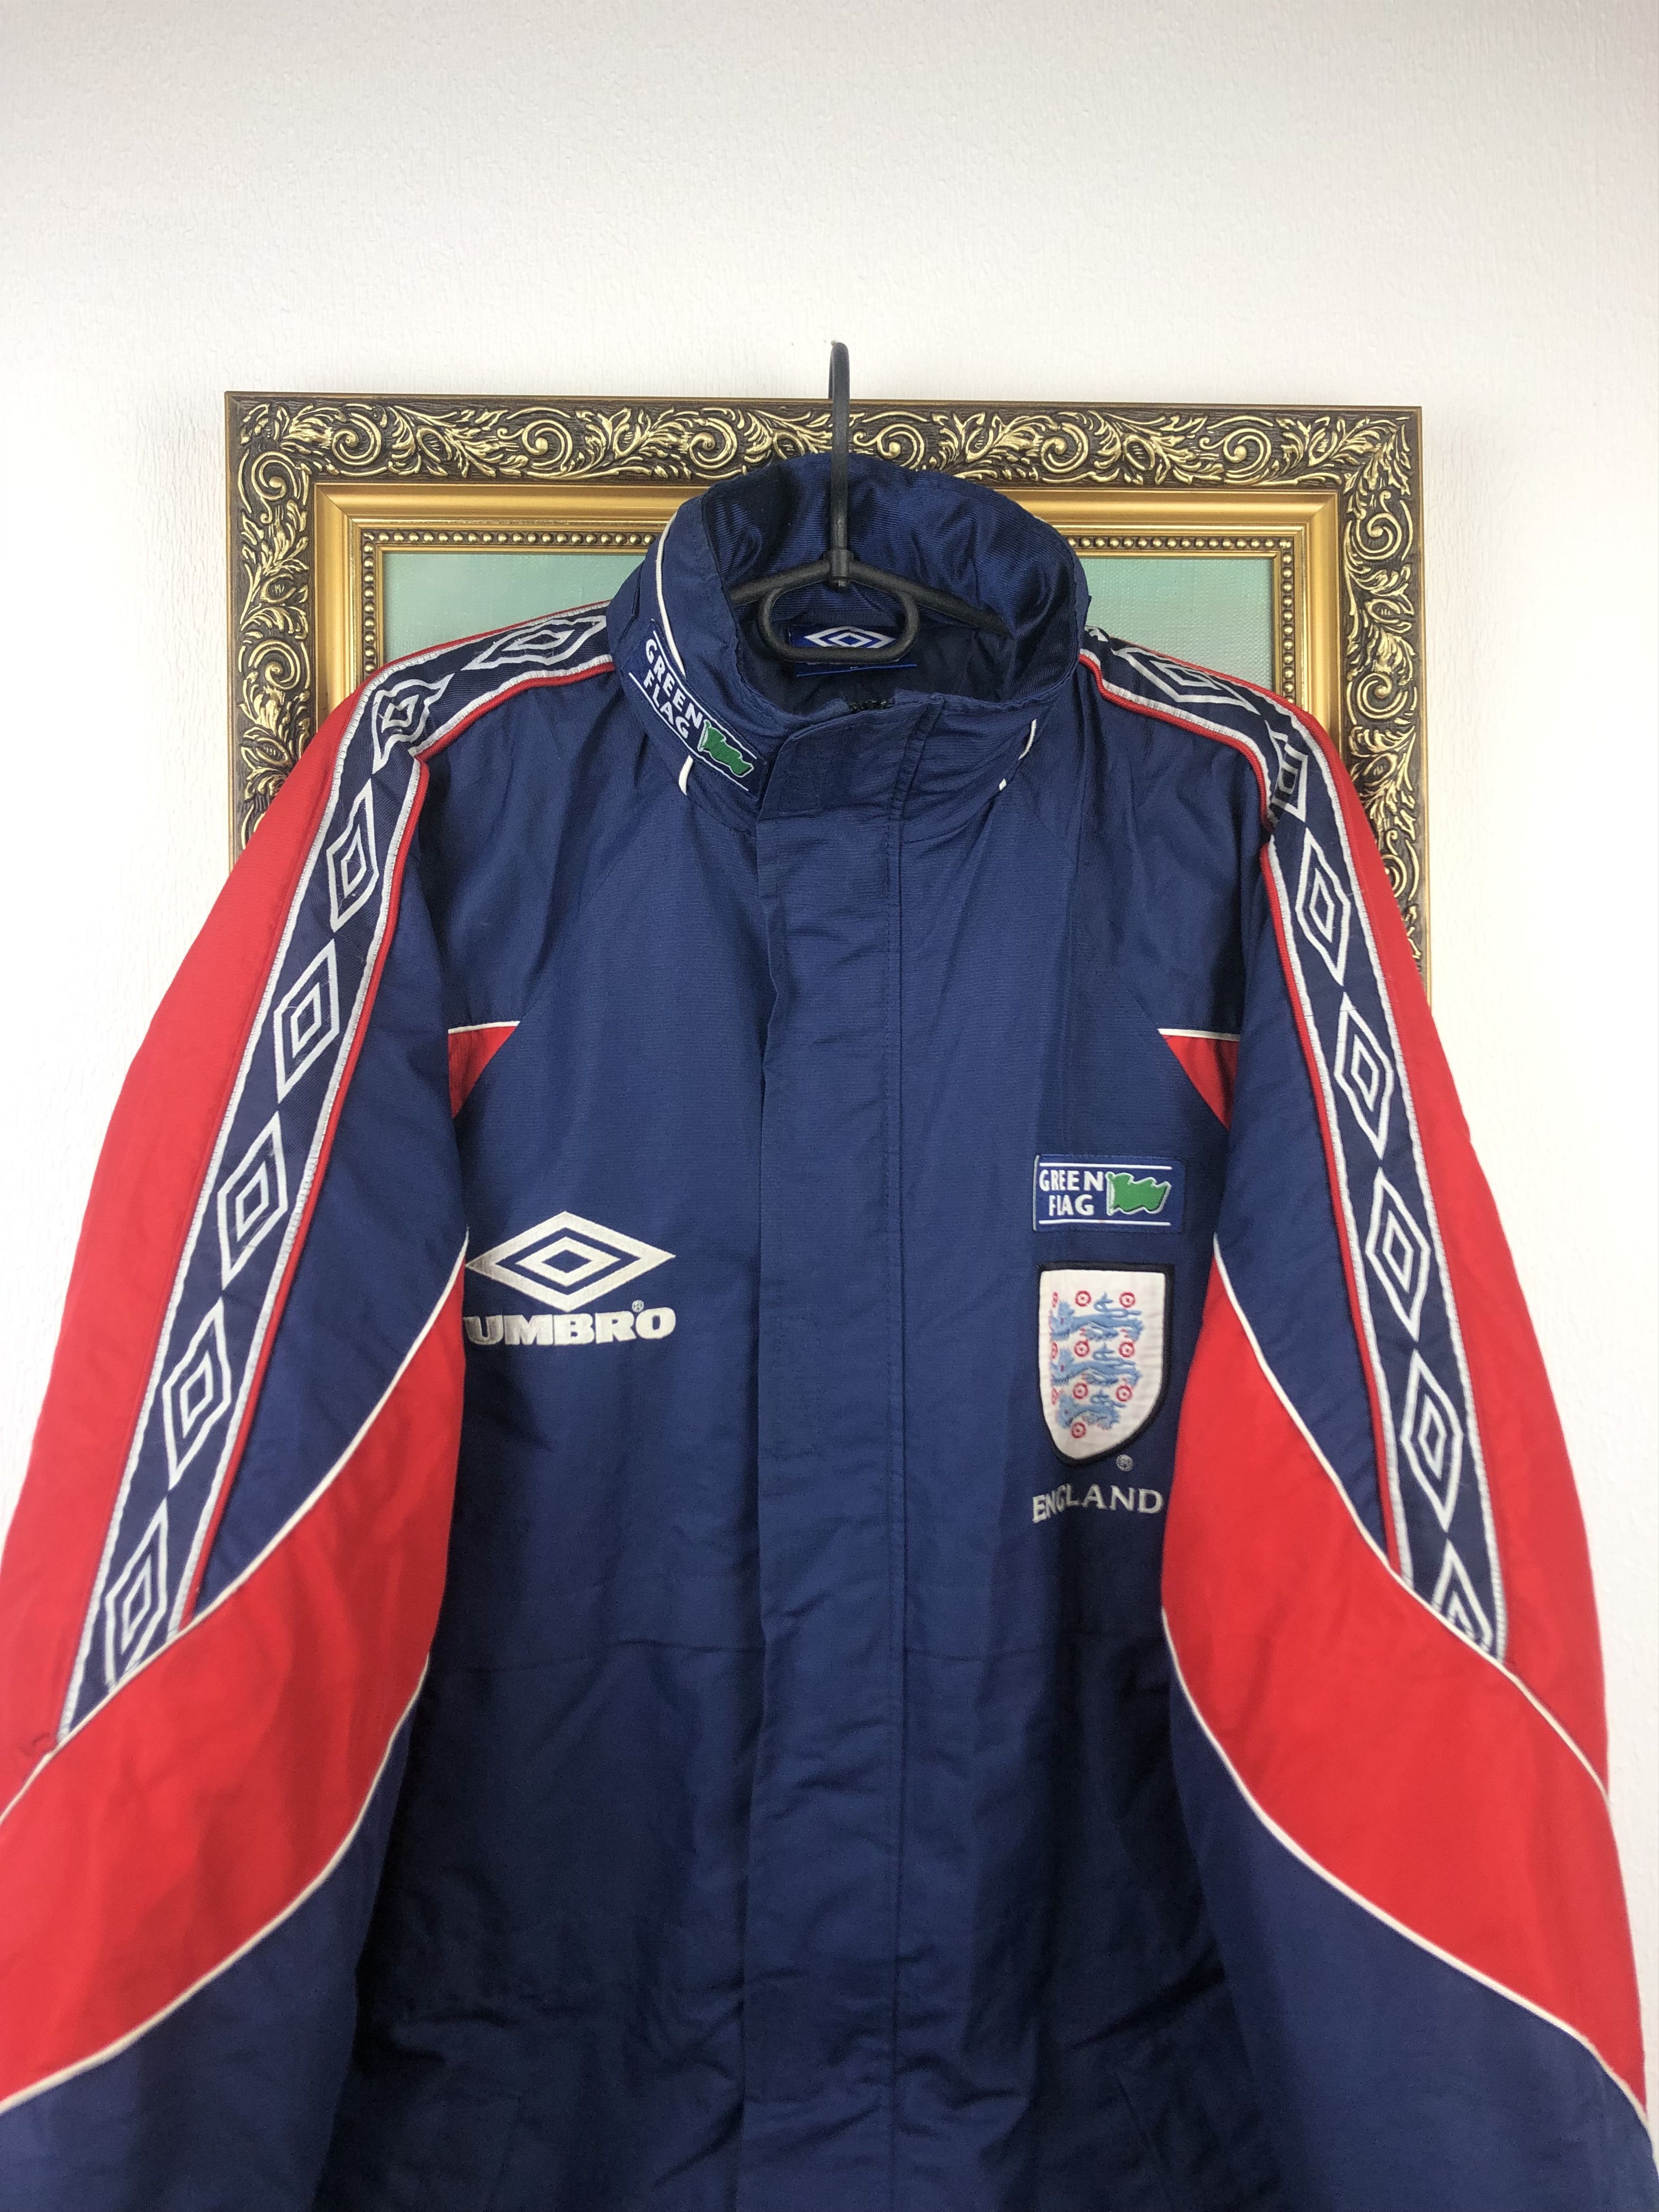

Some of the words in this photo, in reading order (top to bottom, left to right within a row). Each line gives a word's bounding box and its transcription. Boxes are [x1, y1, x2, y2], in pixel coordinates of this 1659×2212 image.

[646, 638, 702, 729] GREEN
[643, 669, 690, 739] FLAG
[1039, 1169, 1104, 1192] GREEN
[1048, 1194, 1094, 1216] FLAG
[463, 1307, 676, 1346] UMBRO
[1032, 1483, 1164, 1523] ENGLAND
